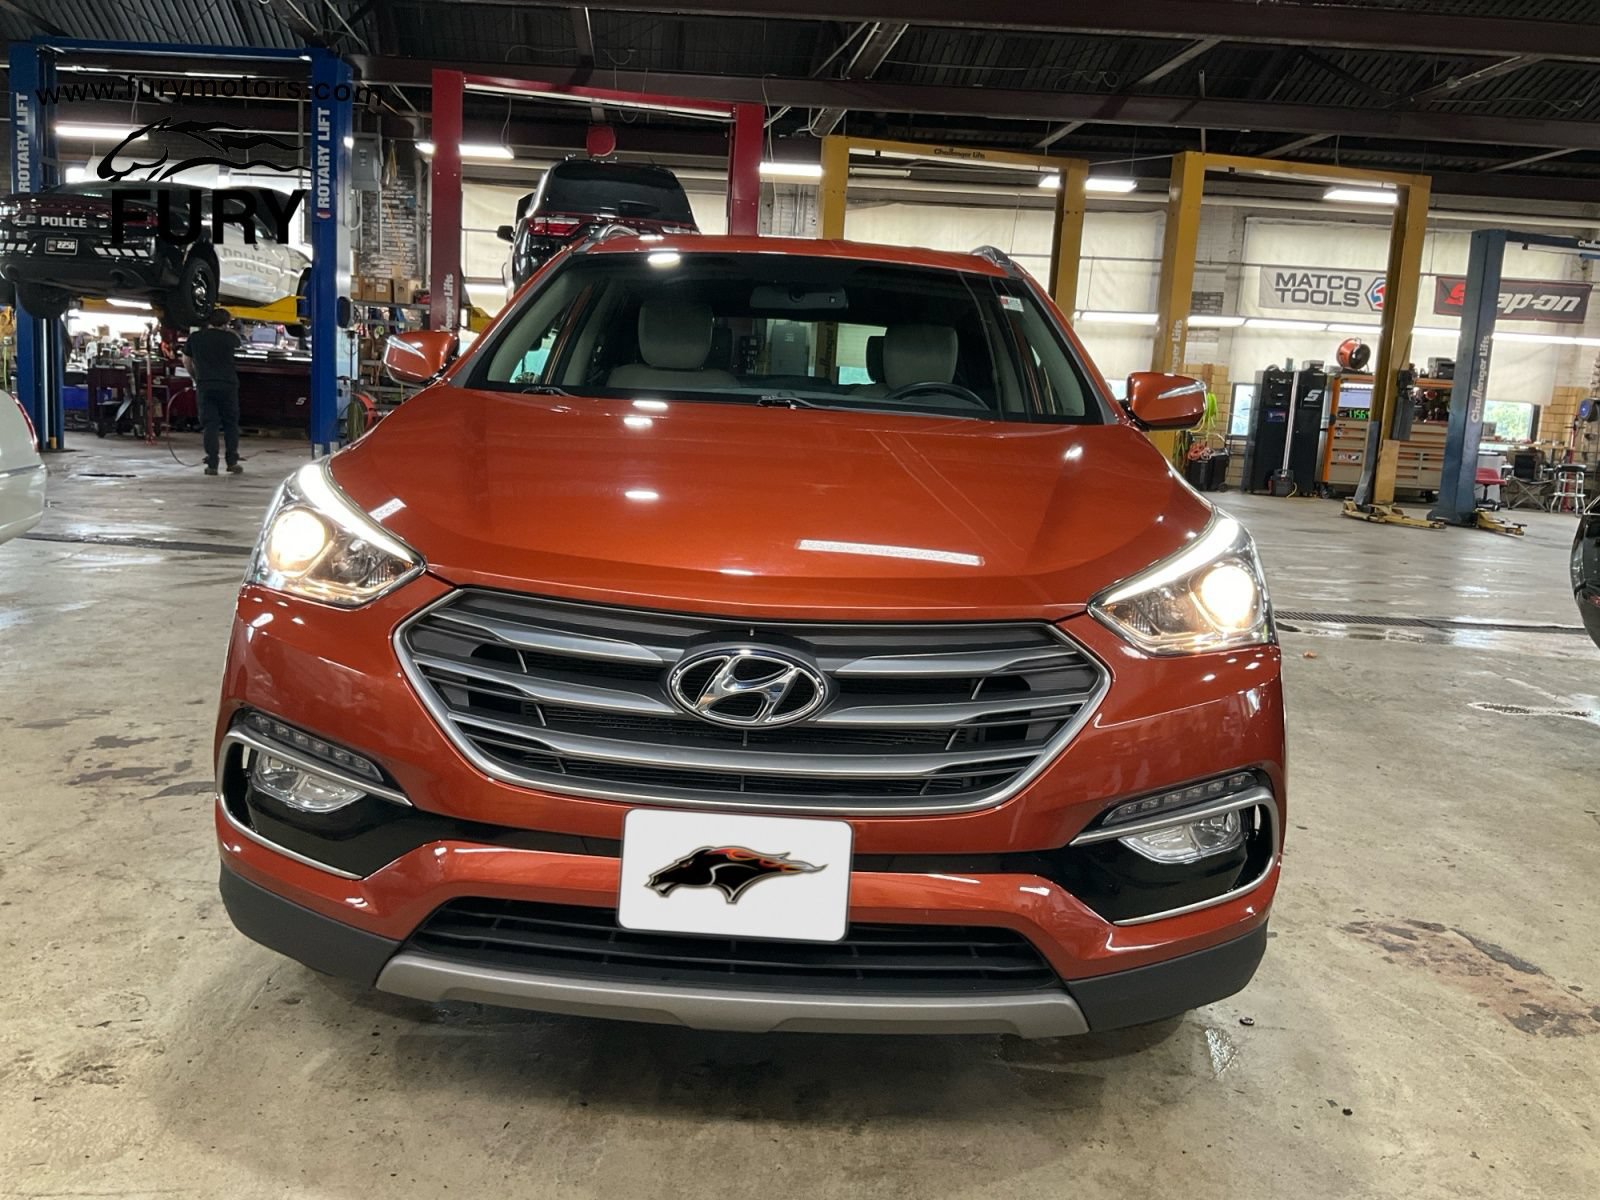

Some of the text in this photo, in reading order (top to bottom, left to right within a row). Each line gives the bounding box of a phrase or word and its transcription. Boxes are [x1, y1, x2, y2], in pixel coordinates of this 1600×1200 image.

[16, 92, 31, 193] ROTARY LIFT
[317, 107, 331, 209] ROTARY LIFT
[41, 216, 87, 229] POLICE
[1275, 272, 1362, 291] MATCO
[1275, 288, 1360, 307] TOOLS
[1471, 335, 1490, 423] Challenger Lifts
